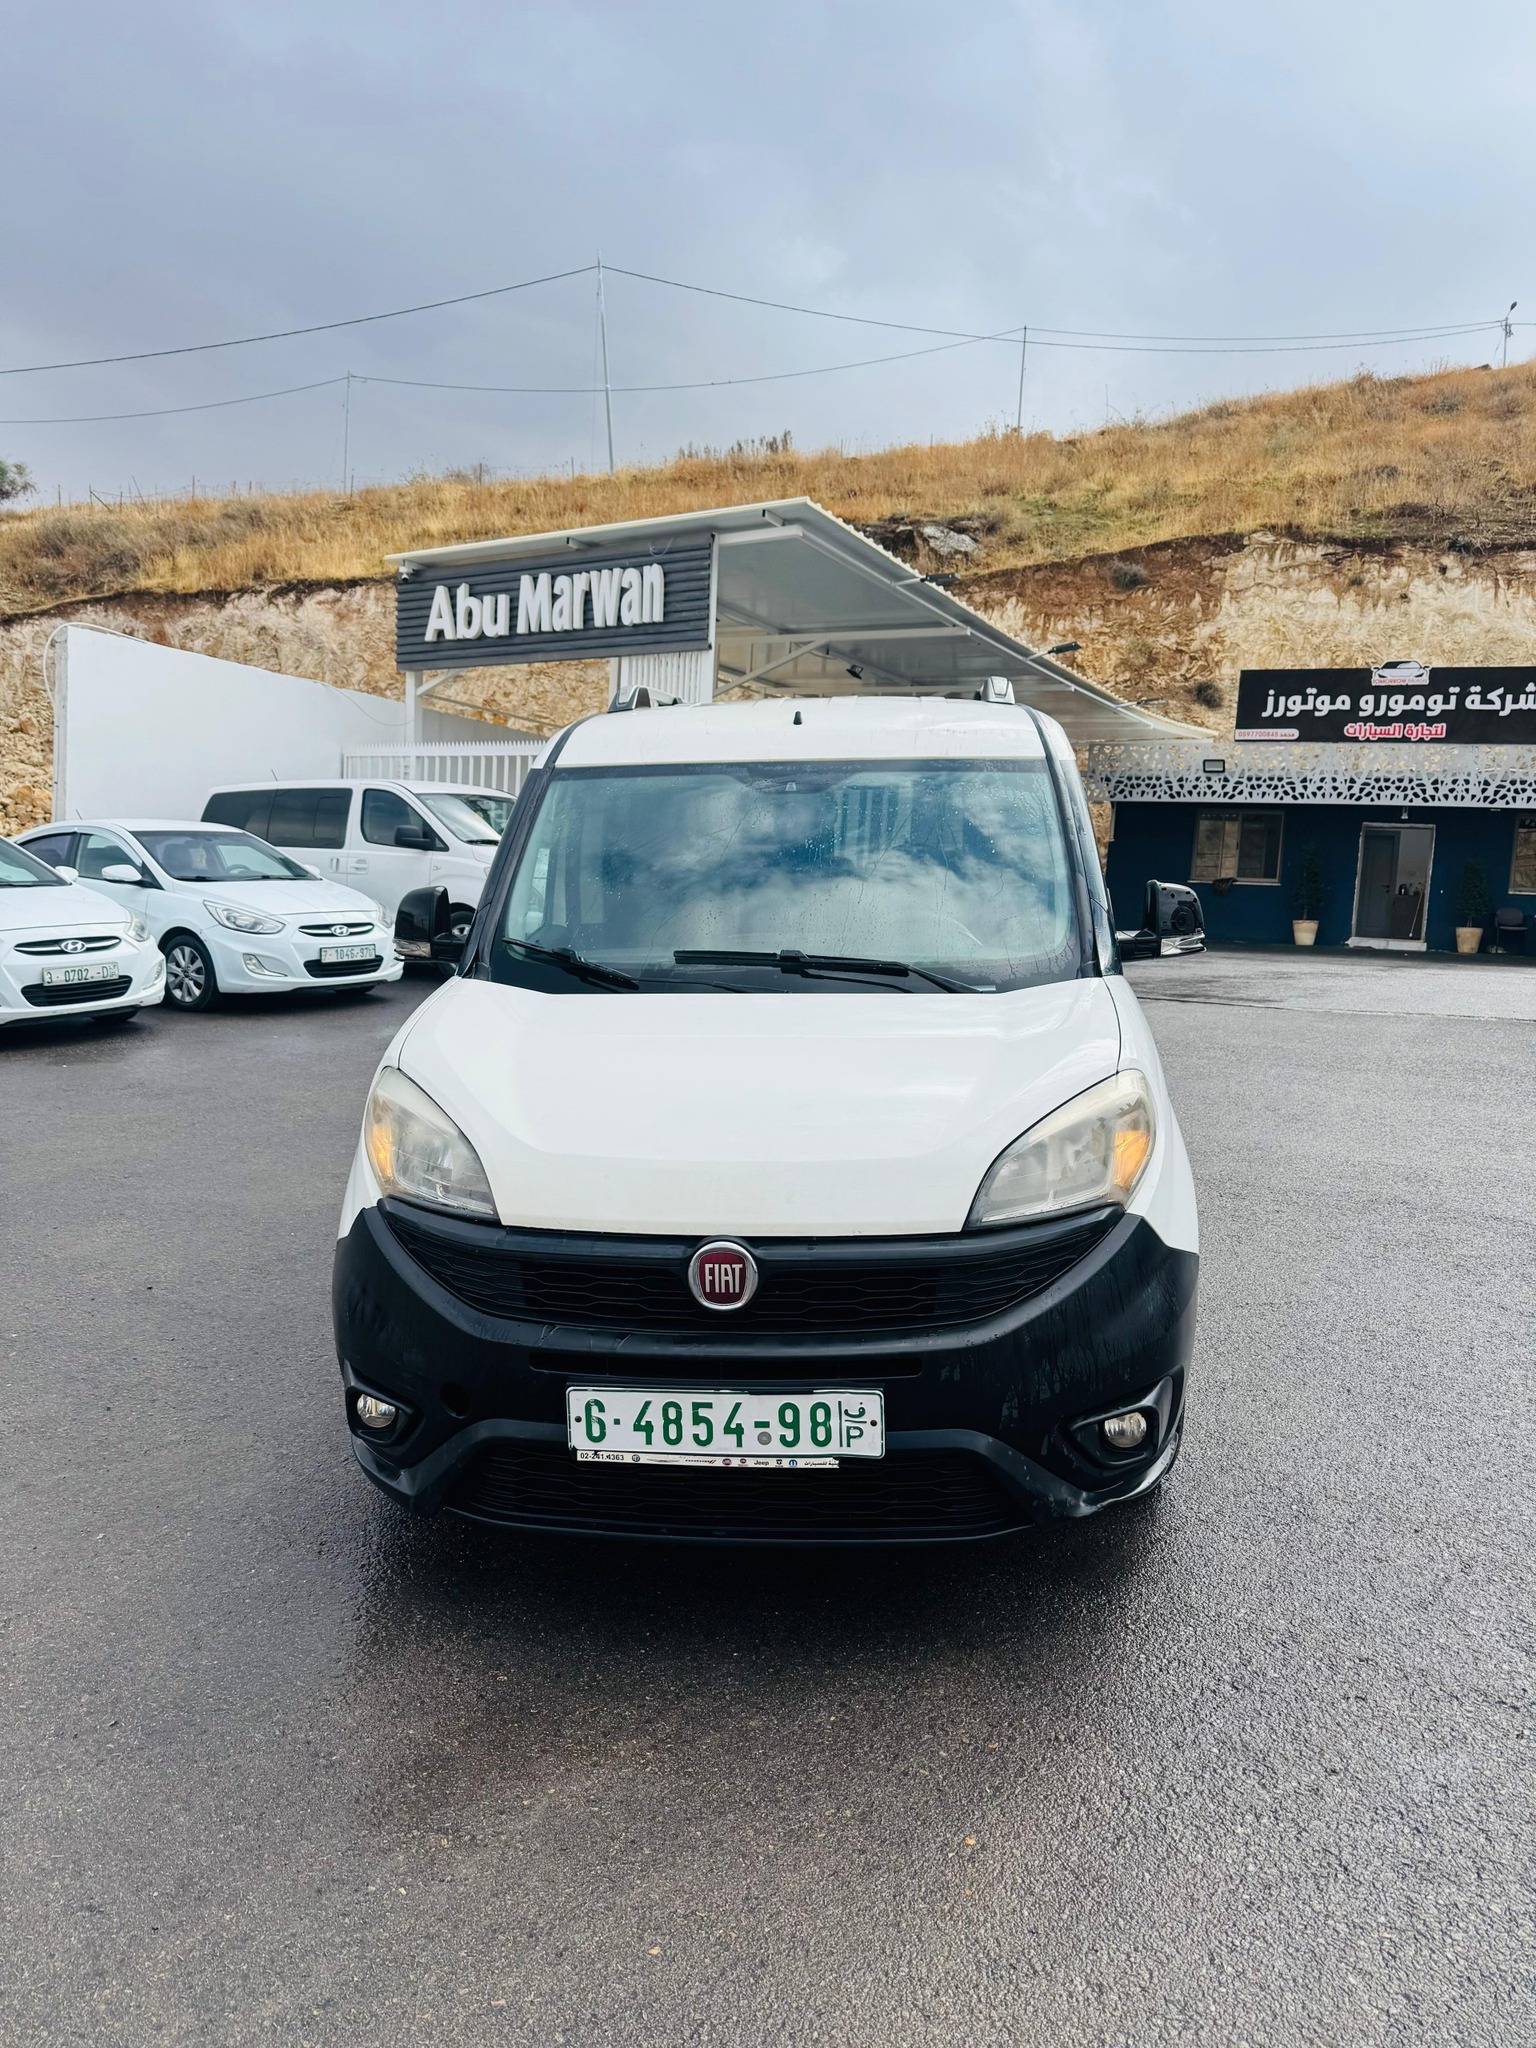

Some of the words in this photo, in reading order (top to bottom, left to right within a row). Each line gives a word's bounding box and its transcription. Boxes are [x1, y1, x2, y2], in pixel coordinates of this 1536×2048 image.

[424, 582, 510, 642] Abu
[516, 563, 664, 635] Marwan
[1261, 687, 1351, 717] موتورز
[1358, 686, 1460, 717] تومورو
[1465, 682, 1536, 717] شركة
[1345, 723, 1402, 740] السيارات
[1405, 724, 1445, 740] لتجارة
[704, 1263, 743, 1293] FIAT
[846, 1426, 864, 1447] P
